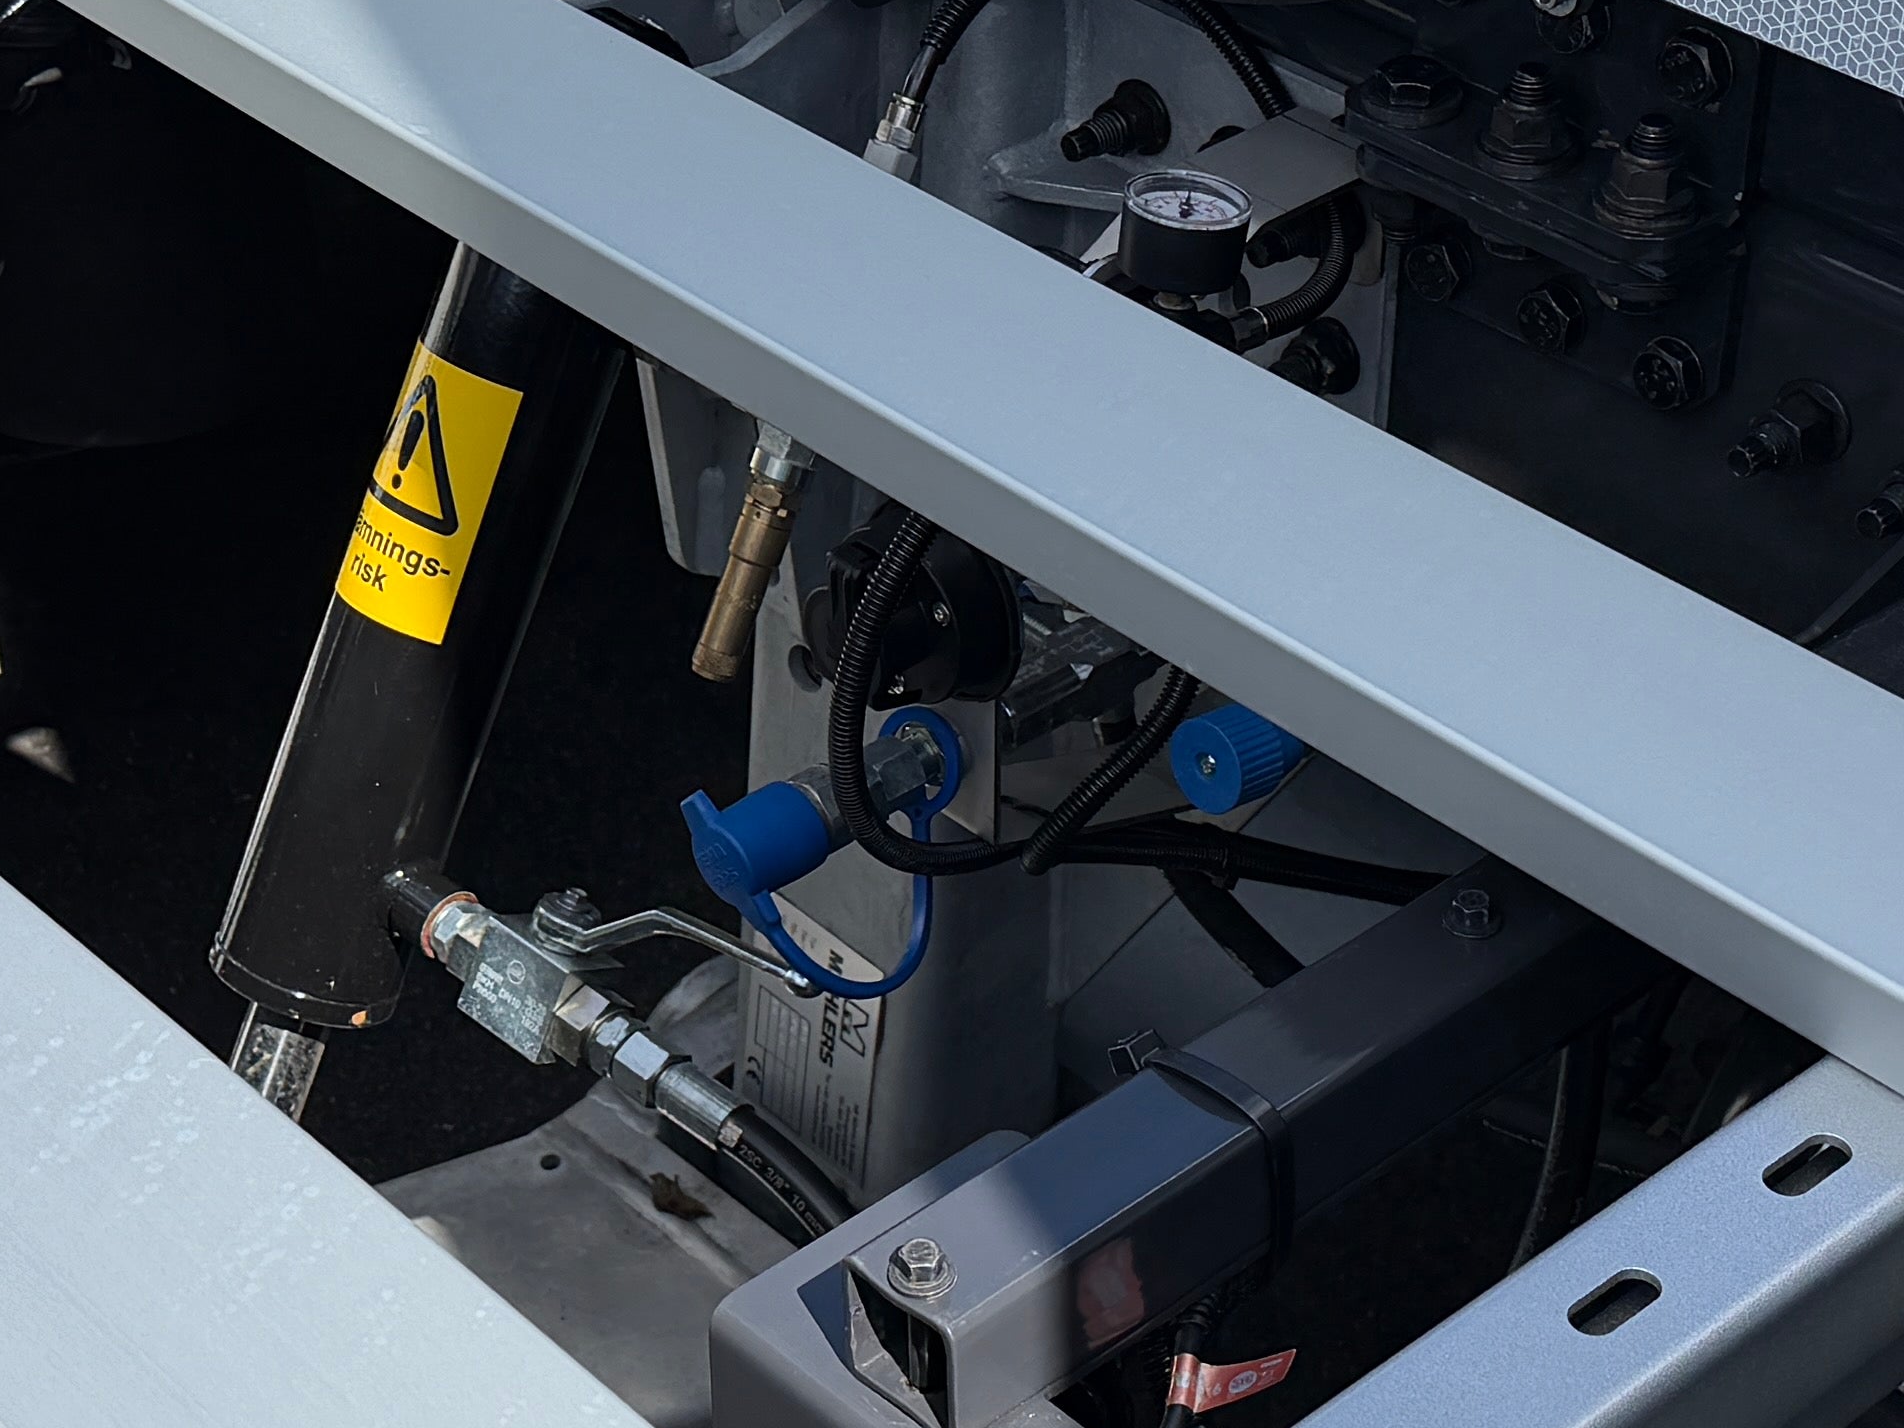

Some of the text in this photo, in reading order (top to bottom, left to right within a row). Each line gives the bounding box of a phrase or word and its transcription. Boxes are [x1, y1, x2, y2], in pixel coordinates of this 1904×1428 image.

[350, 552, 388, 593] risk
[818, 948, 845, 1069] MHLERS
[738, 1144, 764, 1170] 2SC
[791, 1192, 807, 1212] 10
